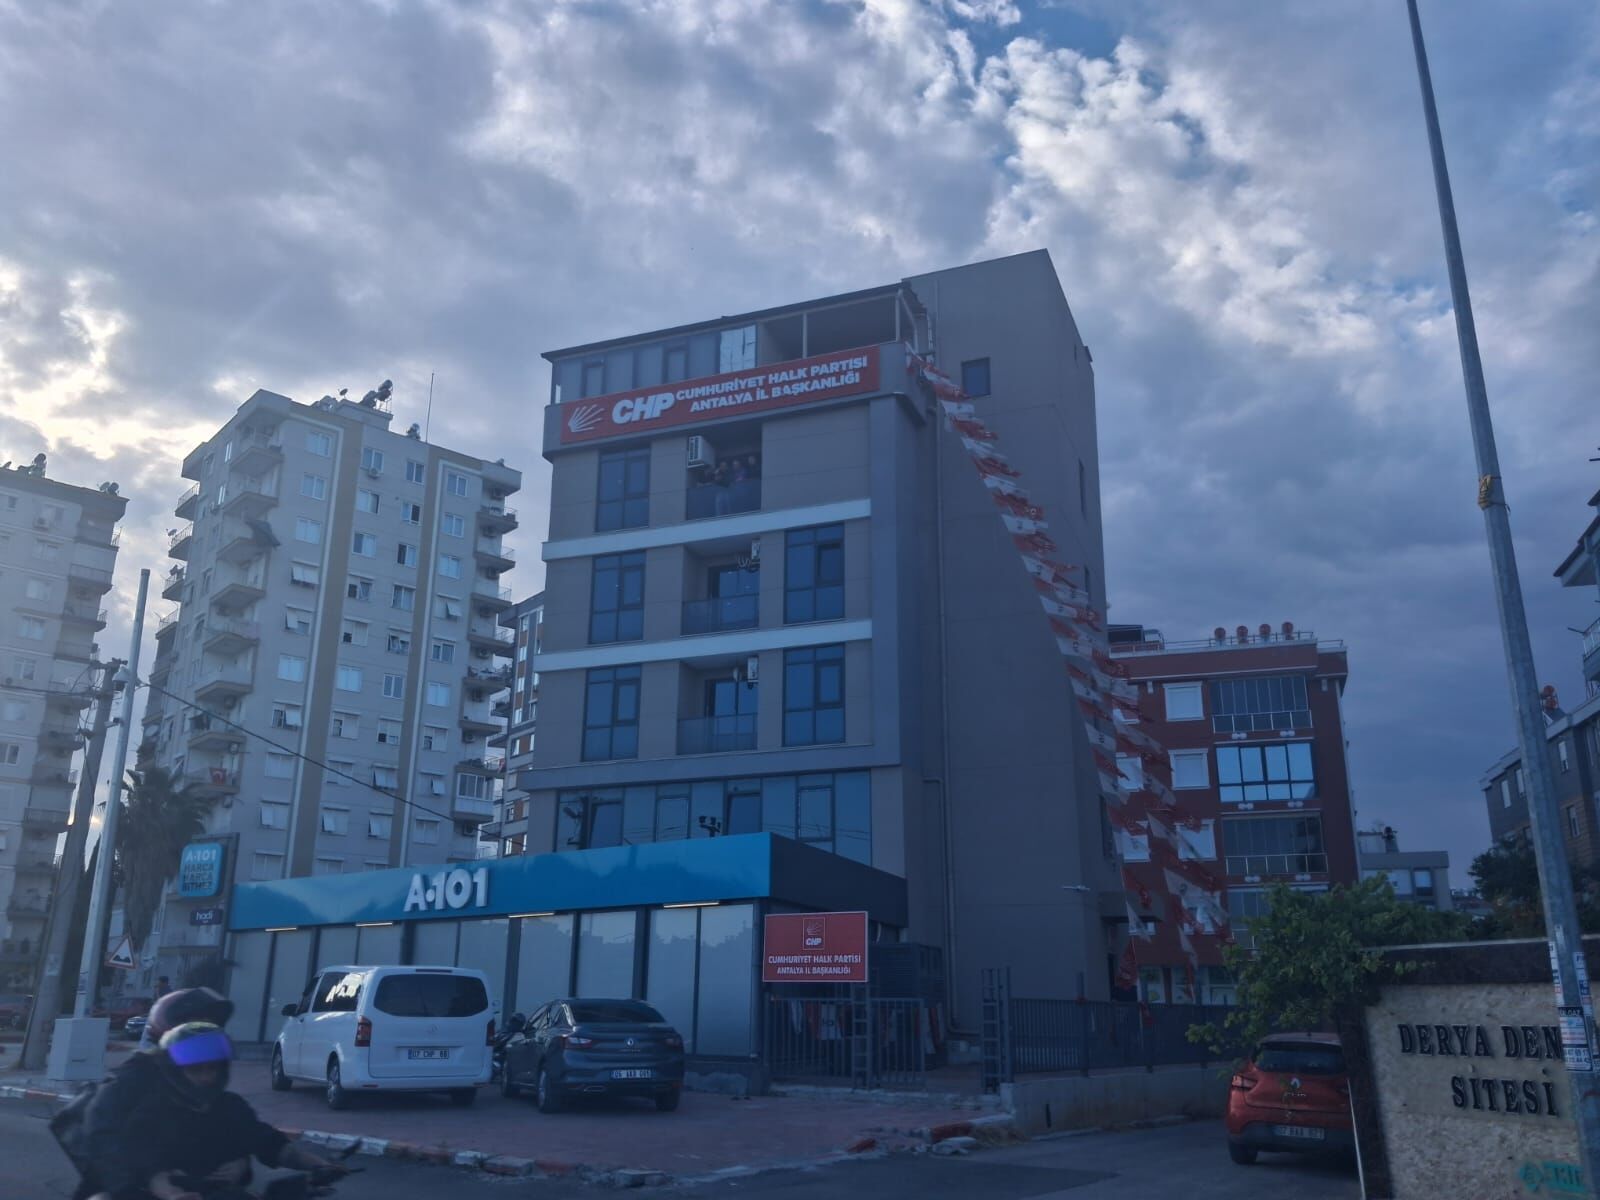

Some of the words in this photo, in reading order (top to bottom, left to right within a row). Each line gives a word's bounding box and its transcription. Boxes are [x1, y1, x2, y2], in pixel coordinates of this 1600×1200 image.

[612, 392, 675, 425] CHP
[676, 375, 766, 400] CUMHURİYET
[768, 367, 807, 385] HALK
[689, 390, 753, 413] ANTALYA
[756, 388, 769, 401] İL
[771, 370, 861, 398] BAŞKANLIĞI
[805, 937, 822, 946] CHP
[813, 954, 832, 963] HALK
[834, 952, 861, 963] PARTİSİ
[777, 966, 803, 974] ANTALYA
[812, 965, 851, 976] BAŞKANLIĞI
[1398, 1023, 1493, 1057] DERYA
[1501, 1025, 1563, 1060] DEN
[1451, 1065, 1560, 1117] SİTESİ
